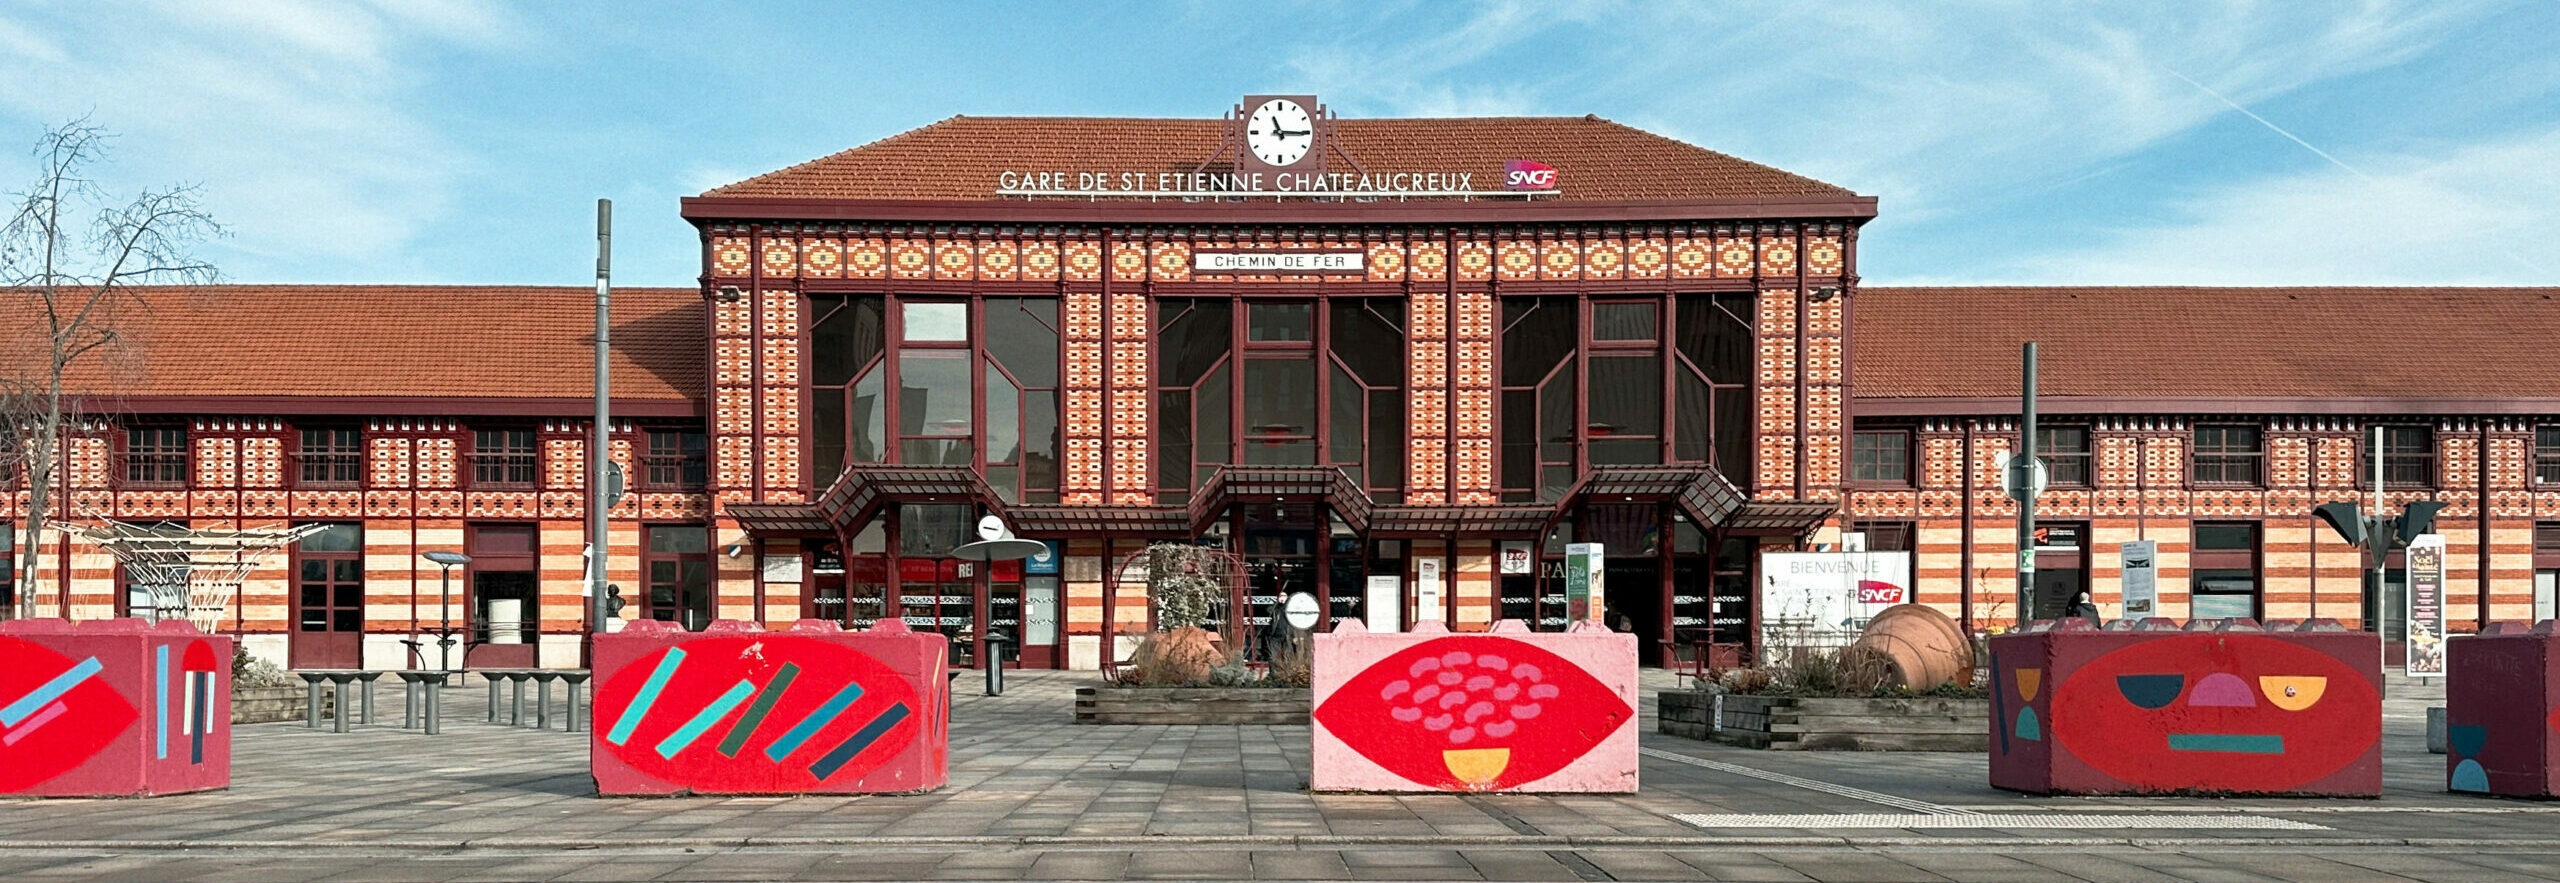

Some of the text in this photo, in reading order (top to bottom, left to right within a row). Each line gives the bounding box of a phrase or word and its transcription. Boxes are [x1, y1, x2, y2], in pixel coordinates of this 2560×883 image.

[999, 170, 1472, 192] GARE DE ST ETIENNE CHATEAUCREUX
[1507, 169, 1555, 186] SNCF
[1214, 256, 1345, 267] CHEMIN DE FER
[1790, 560, 1881, 574] BIENVENUE
[1859, 588, 1900, 601] SNCF
